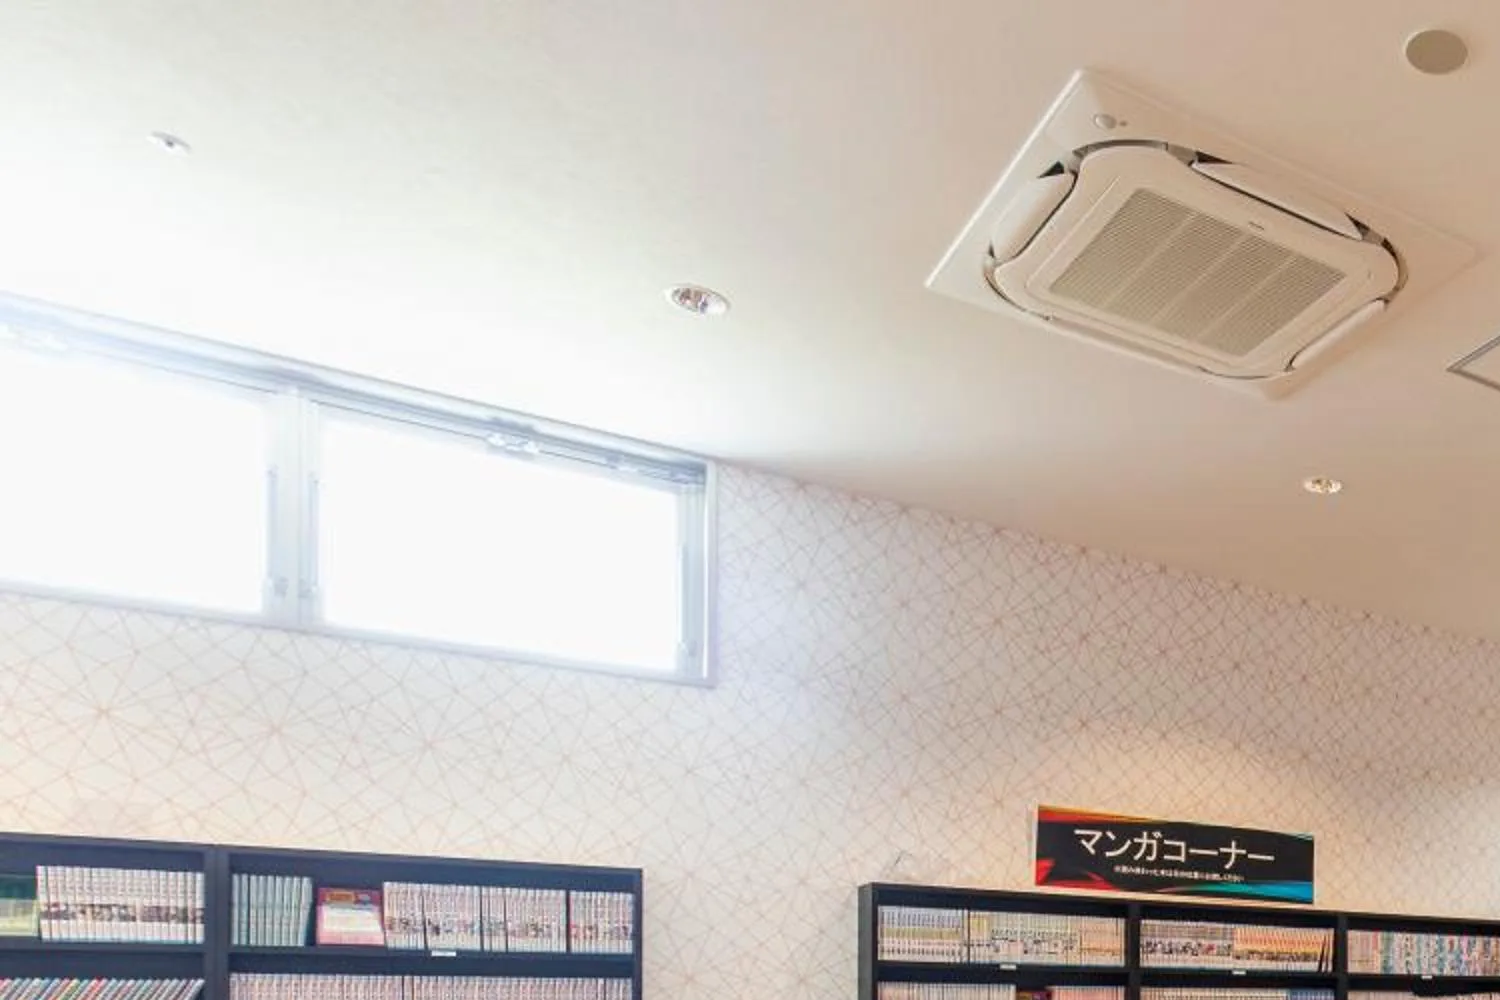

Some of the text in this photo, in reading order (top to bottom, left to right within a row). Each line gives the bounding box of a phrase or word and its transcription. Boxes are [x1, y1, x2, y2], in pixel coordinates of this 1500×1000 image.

[1074, 828, 1275, 869] マンガコーナー
